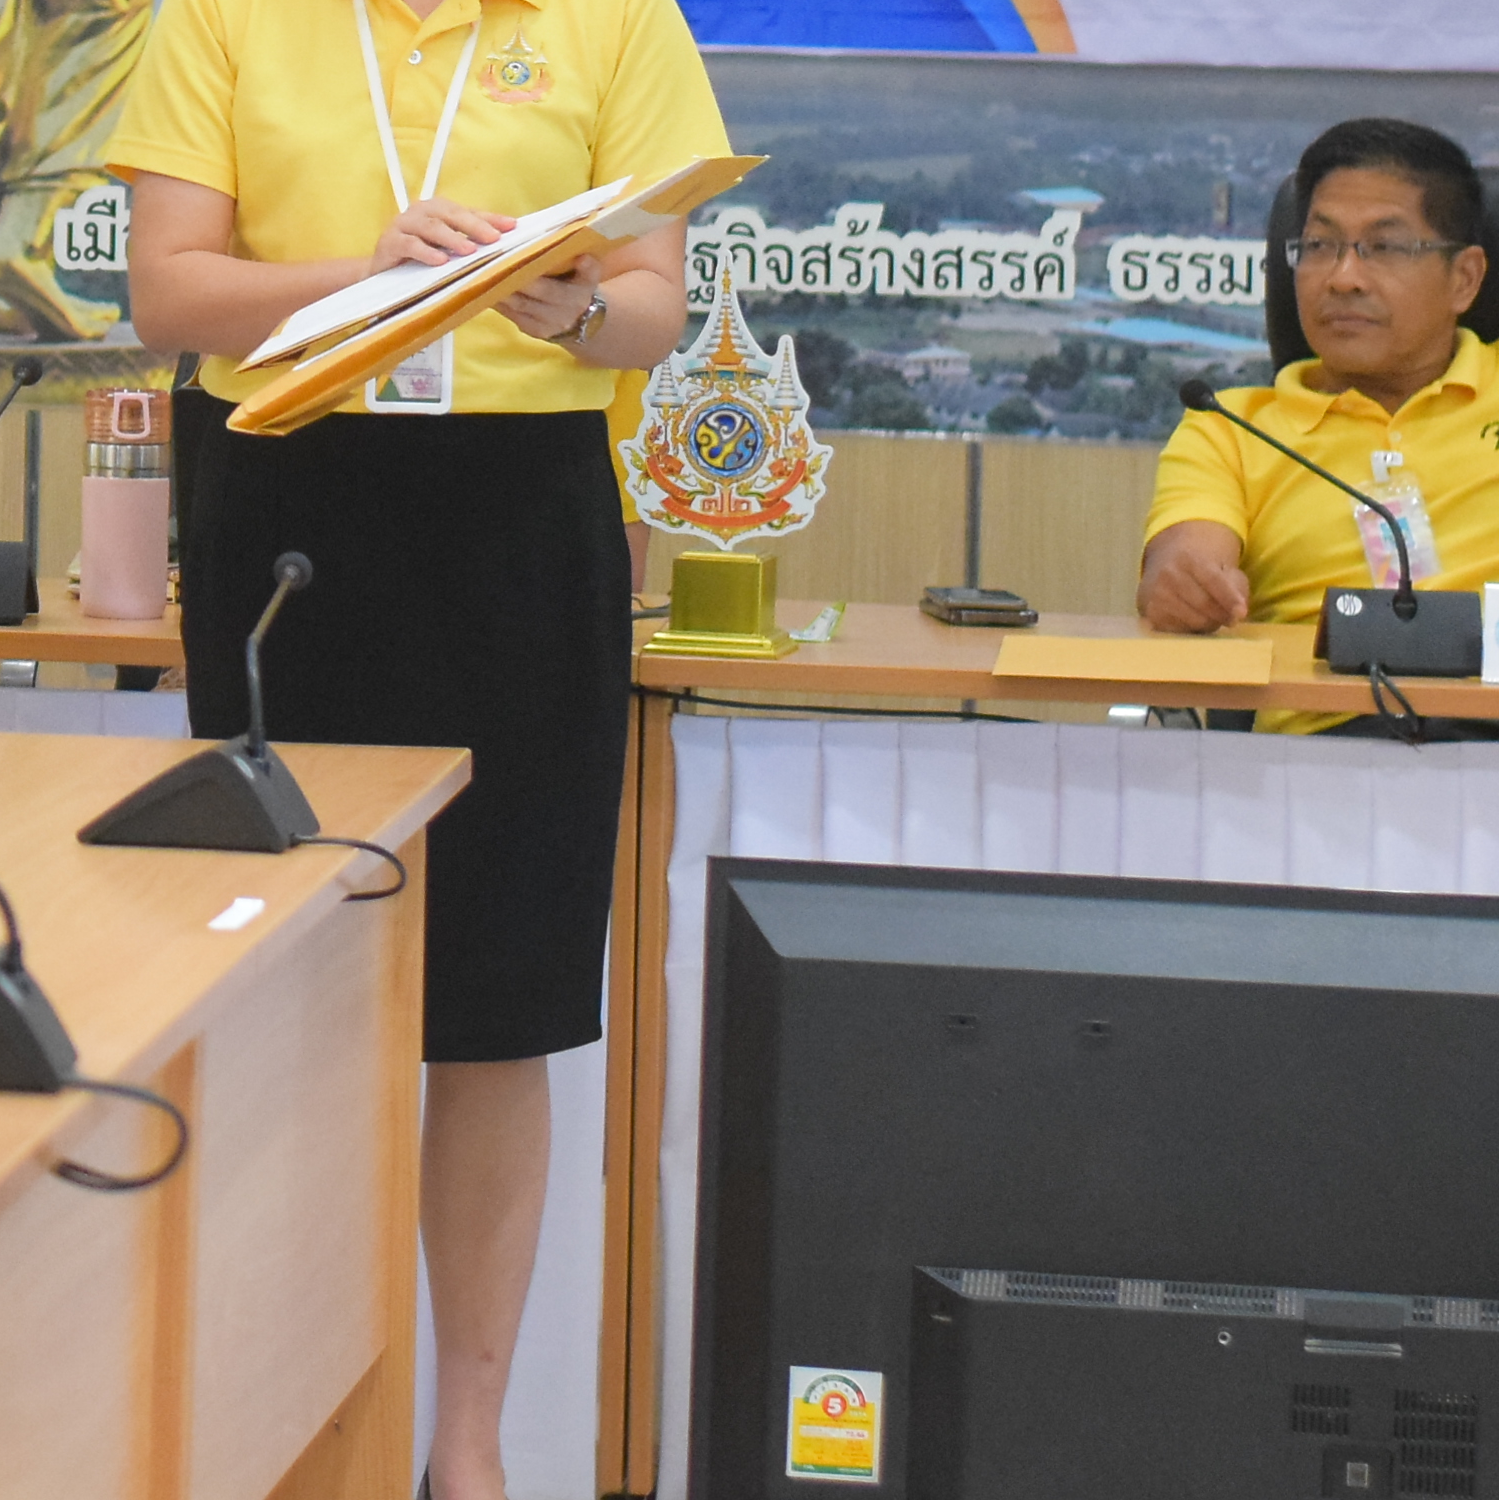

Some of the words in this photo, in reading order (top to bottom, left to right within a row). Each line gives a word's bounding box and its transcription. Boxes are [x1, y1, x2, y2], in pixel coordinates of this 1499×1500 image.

[66, 198, 129, 263] เมื
[685, 220, 1067, 306] ฐกิจสร้างสรรค์
[1121, 250, 1266, 295] ธรรม
[826, 1397, 843, 1416] 5
